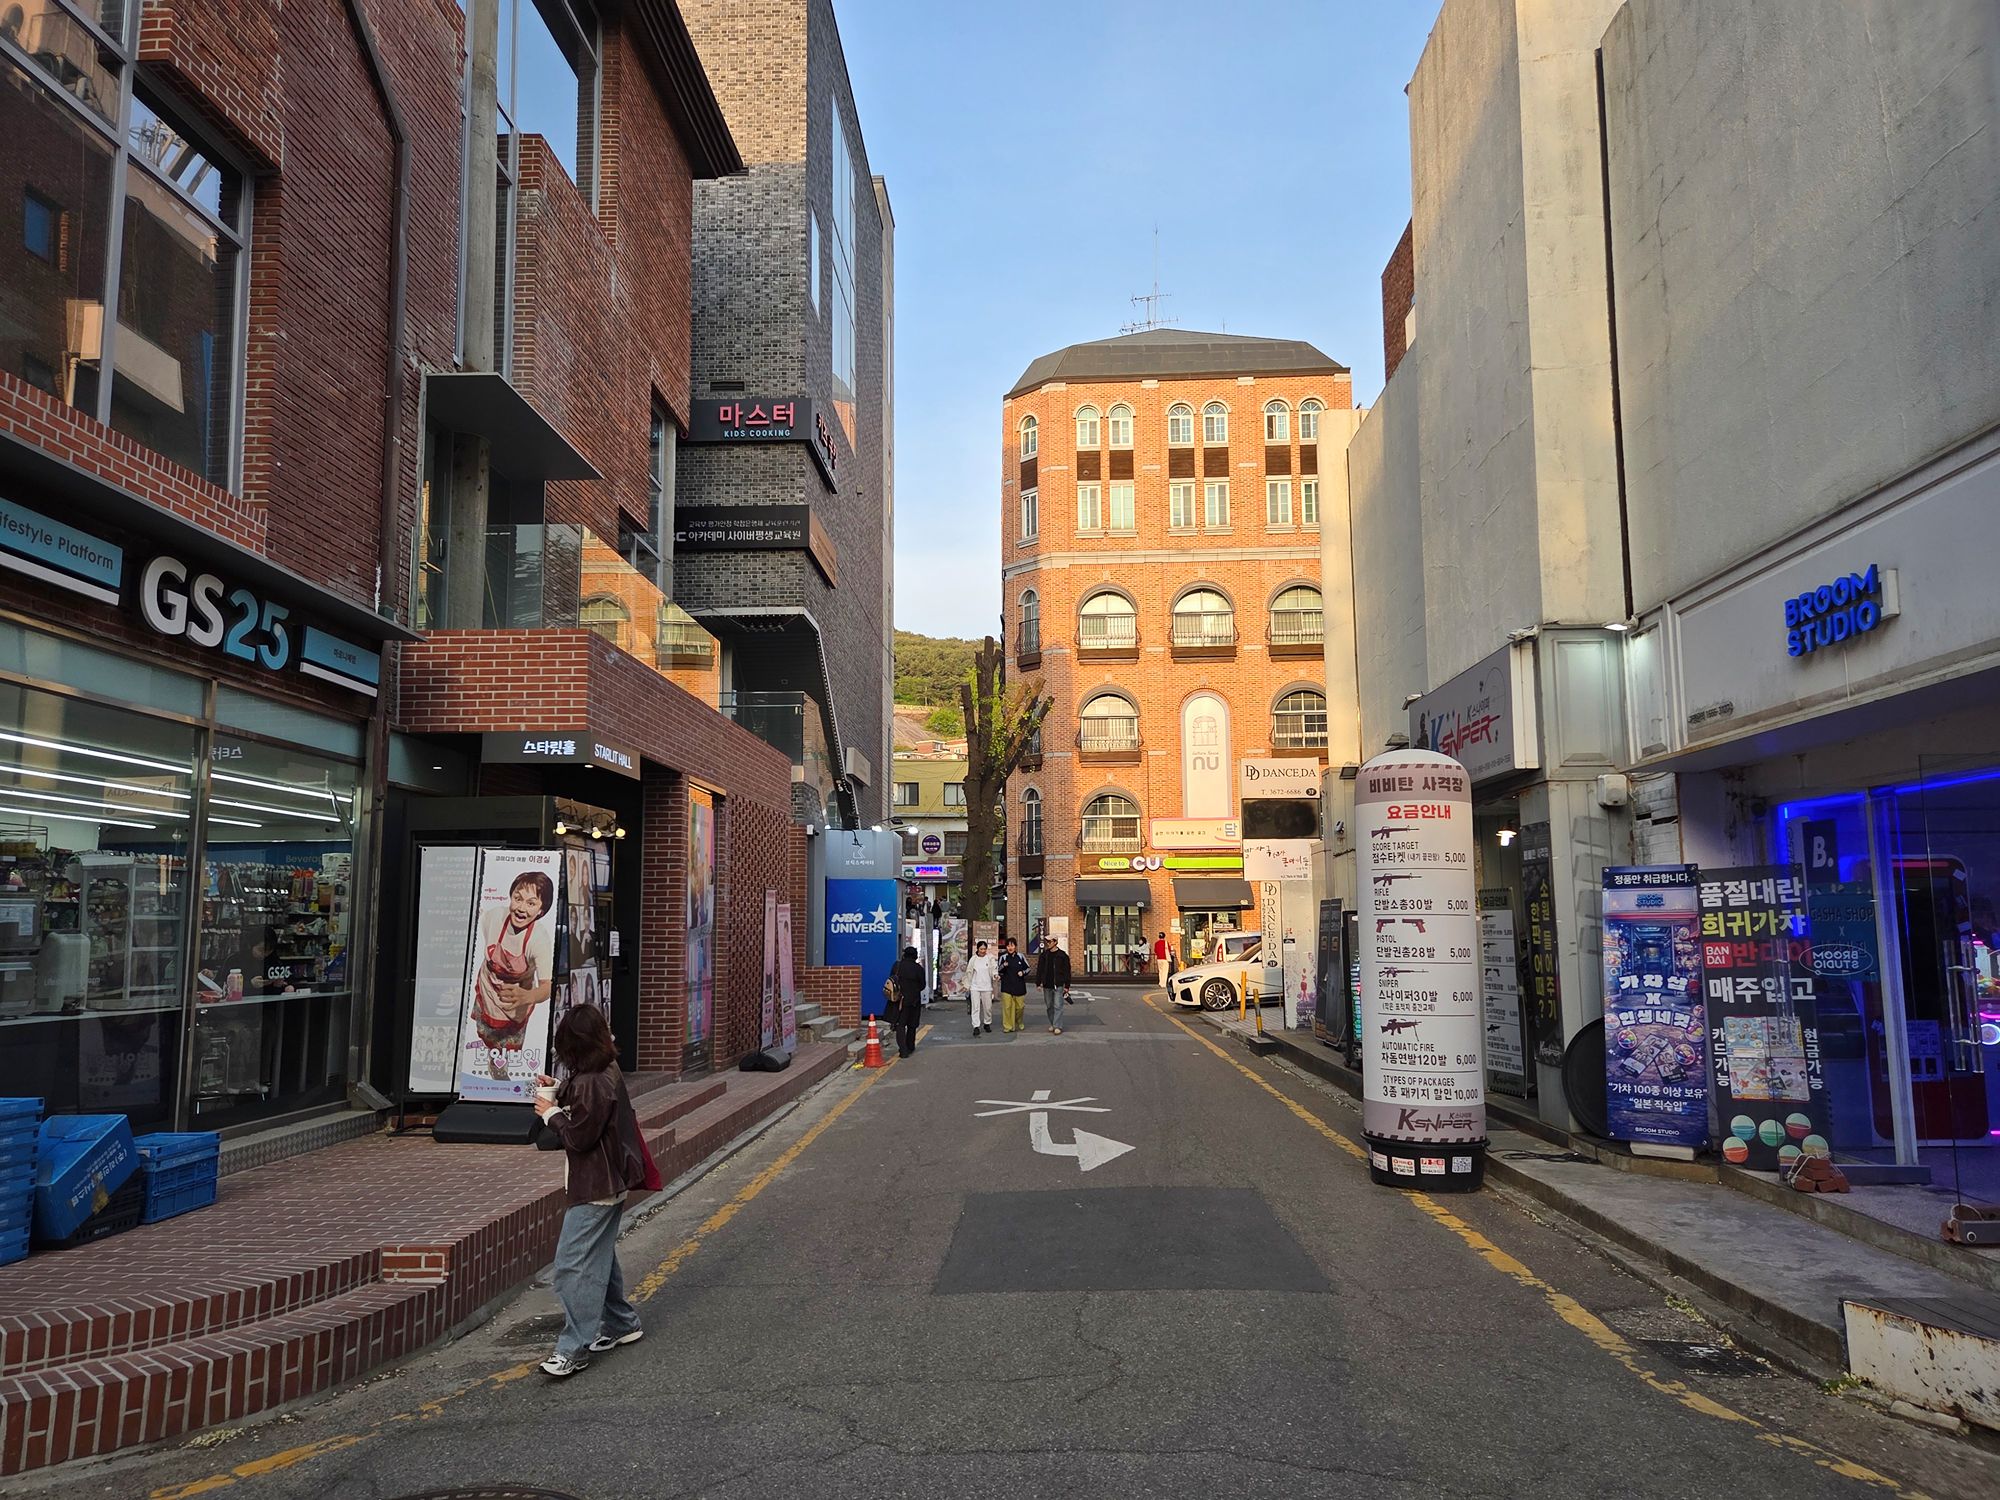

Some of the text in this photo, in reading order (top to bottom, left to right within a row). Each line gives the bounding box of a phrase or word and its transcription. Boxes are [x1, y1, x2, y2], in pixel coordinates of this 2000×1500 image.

[719, 402, 795, 428] 마스터
[724, 429, 791, 438] KIDS COOKING
[0, 509, 114, 571] ifestyle Platform
[688, 531, 725, 541] 아카데미
[727, 530, 801, 541] 사이버평생교육원
[1784, 563, 1879, 629] BROOM
[140, 555, 289, 671] GS25
[1786, 599, 1882, 658] STUDIO
[523, 740, 577, 755] 스타릿홀
[594, 744, 633, 769] STARLIT HALL
[1369, 776, 1463, 793] 비비탄 사격장
[1387, 804, 1452, 820] 요금안내
[1372, 841, 1419, 851] SCORE TARGET
[1812, 835, 1835, 869] B.
[1132, 856, 1161, 871] CU
[1372, 852, 1406, 864] 점수타켓
[1444, 852, 1466, 864] 5,000
[1614, 873, 1691, 885] 정품만 취급합니다.
[1374, 888, 1389, 896] RIFLE
[1699, 876, 1803, 908] 품절대란
[1374, 898, 1469, 911] 단발소총30발 5,000
[1844, 906, 1875, 921] SHOP
[831, 922, 893, 933] UNIVERSE
[1701, 908, 1807, 937] 희귀가챠
[1376, 934, 1397, 943] PISTOL
[1376, 946, 1436, 959] 단발권총28발
[1450, 947, 1471, 959] 5,000
[1705, 946, 1730, 956] BAN
[1707, 956, 1726, 965] DAI
[268, 966, 291, 979] GS25
[1544, 930, 1559, 1019] 들어주기
[1378, 979, 1399, 988] SNIPER
[1708, 975, 1817, 1004] 매주입고
[1378, 989, 1473, 1003] 스나이퍼30발 6,000
[1381, 1041, 1435, 1052] AUTOMATIC FIRE
[1381, 1052, 1477, 1067] 자동연발120발 6,000
[1711, 1027, 1731, 1087] 카드가능
[1803, 1028, 1824, 1090] 현금가능
[1408, 1077, 1416, 1085] OF
[1418, 1077, 1455, 1086] PACKAGES
[1382, 1085, 1478, 1101] 3종 패키지 할인 10,000
[1633, 1085, 1661, 1096] 100종
[1662, 1087, 1683, 1098] 이상
[1684, 1088, 1708, 1100] 보유”
[1629, 1098, 1688, 1112] “일본 직수입”
[1635, 1126, 1680, 1136] BROOM STUDIO
